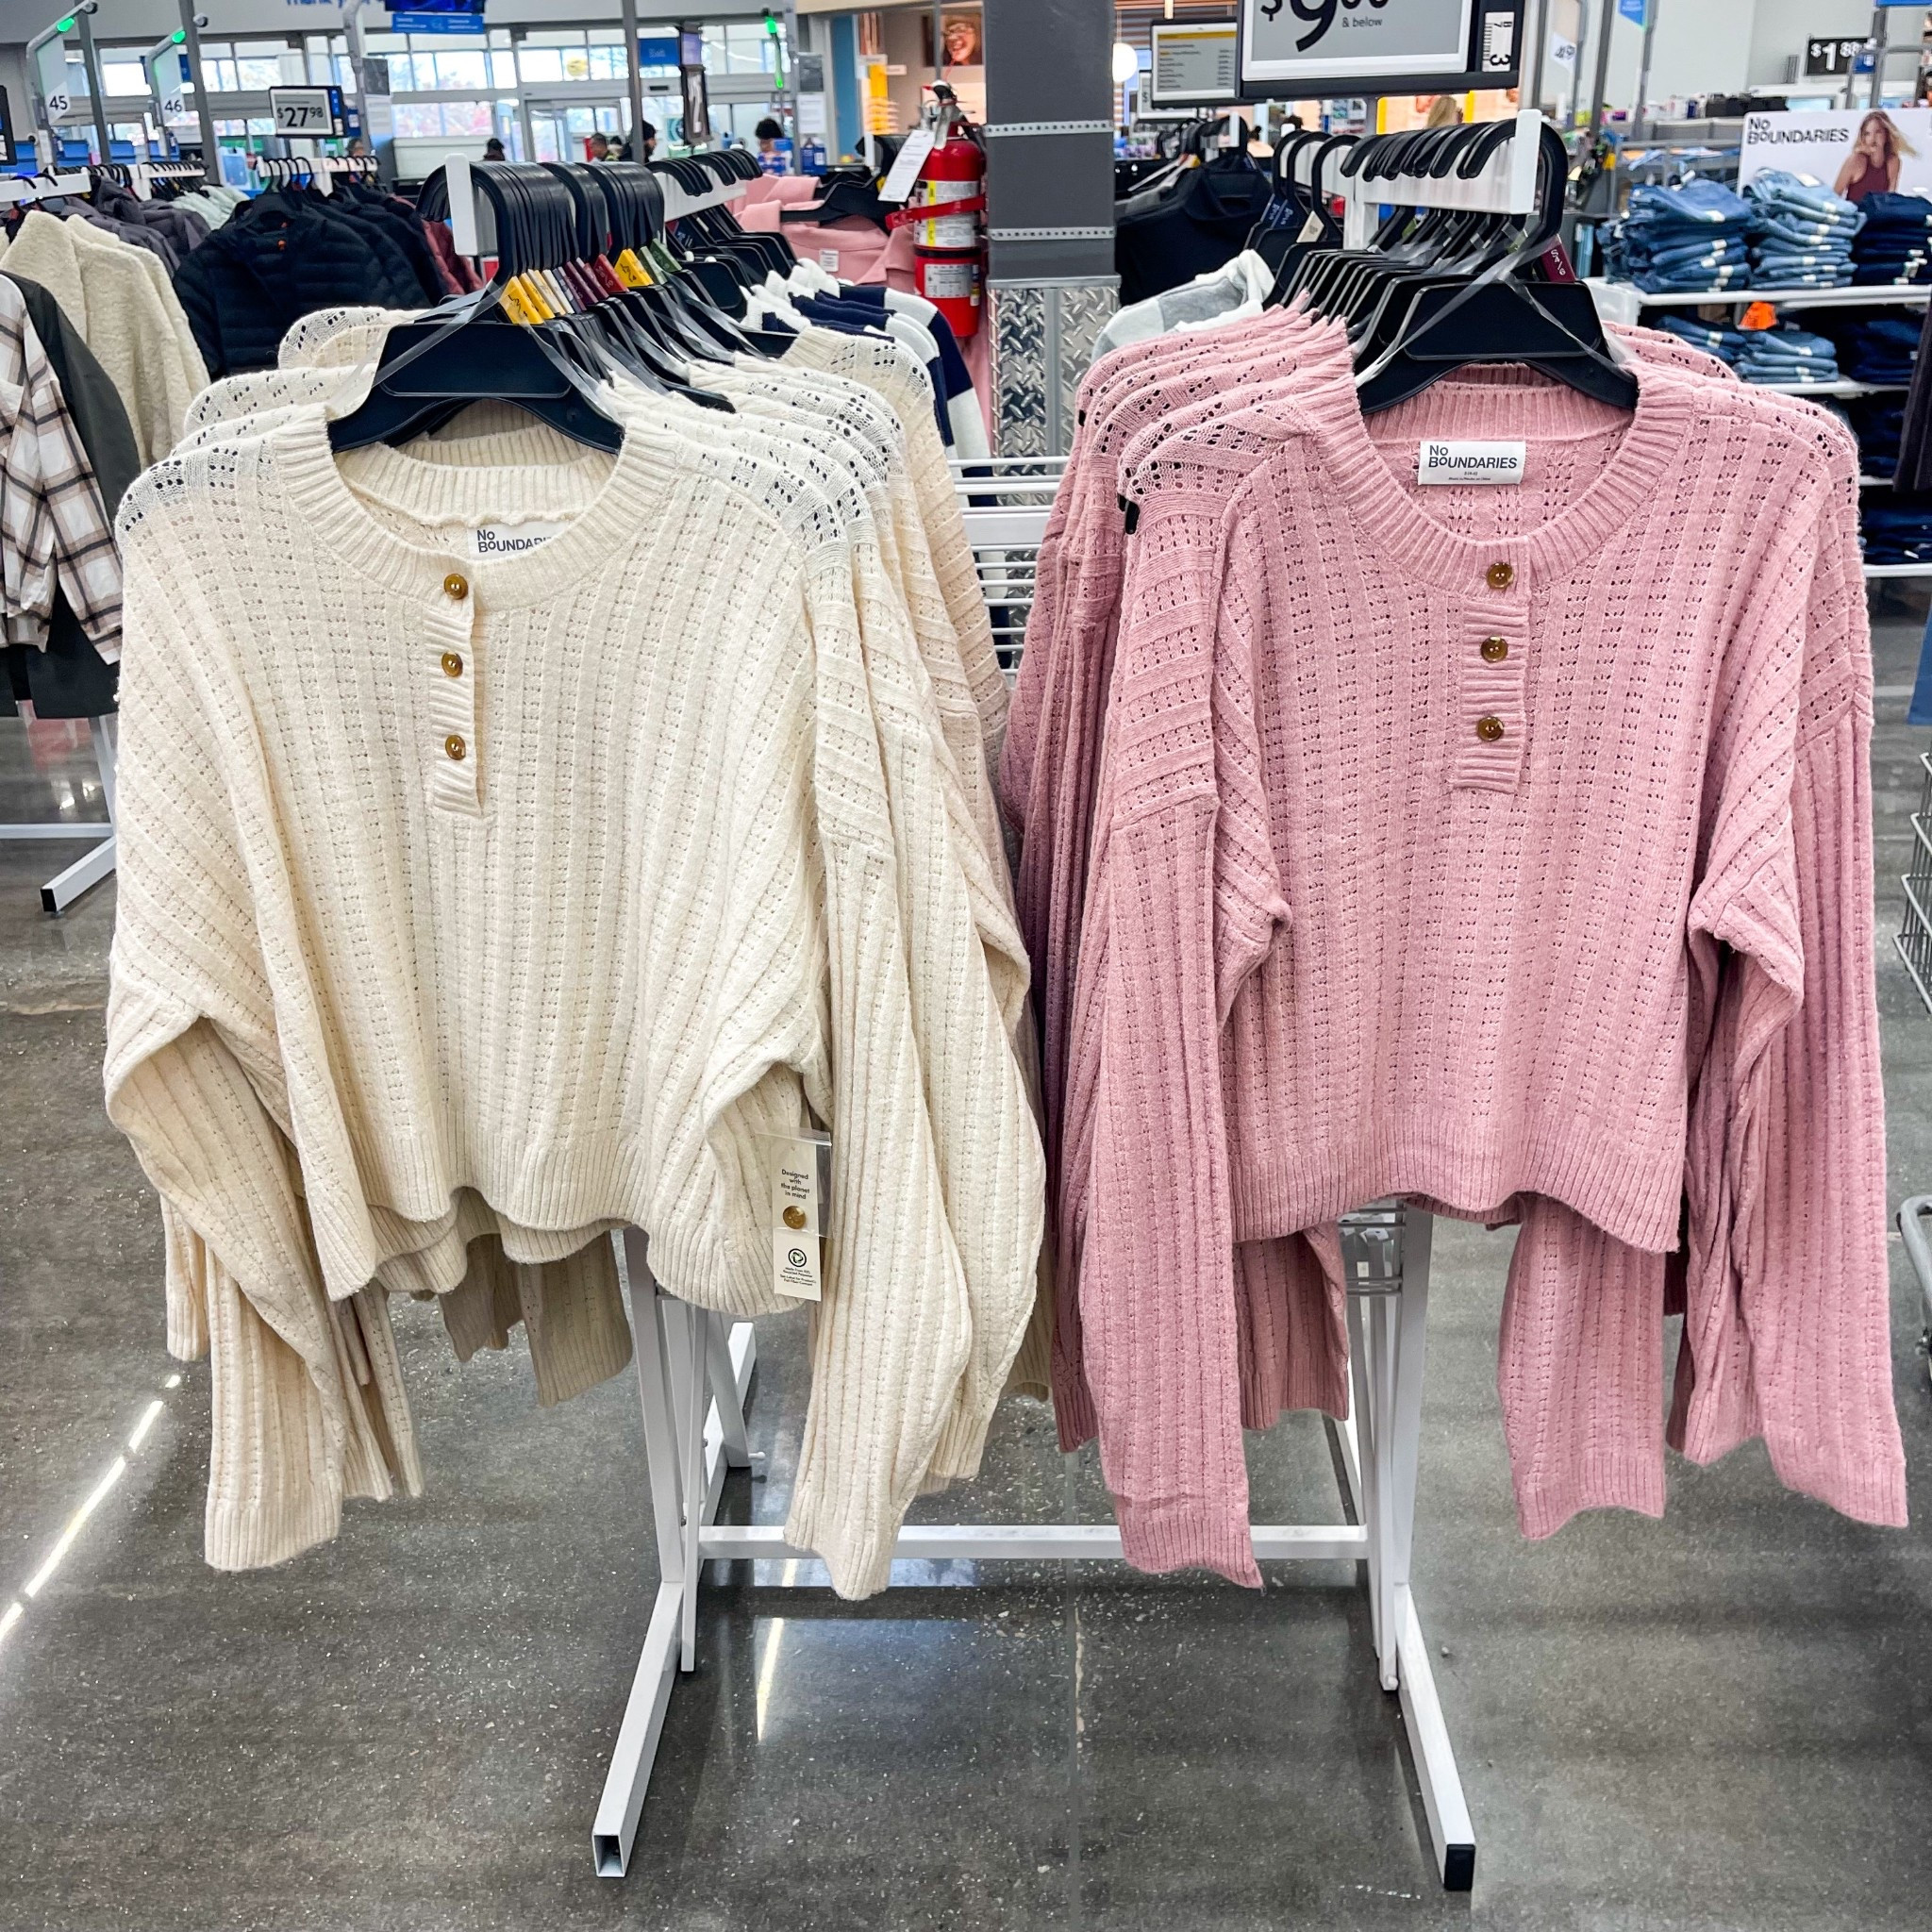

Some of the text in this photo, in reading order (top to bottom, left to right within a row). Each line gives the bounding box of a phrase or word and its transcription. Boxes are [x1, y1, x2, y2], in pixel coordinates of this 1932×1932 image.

[1342, 16, 1383, 27] & below
[49, 95, 69, 110] 45
[164, 99, 183, 112] 46
[1748, 117, 1771, 130] No
[1747, 128, 1849, 144] BOUNDARIES
[1429, 445, 1449, 457] No
[1428, 457, 1518, 469] BOUNDARIES
[476, 529, 495, 541] No
[781, 1169, 809, 1180] Designed
[791, 1185, 810, 1193] planet
